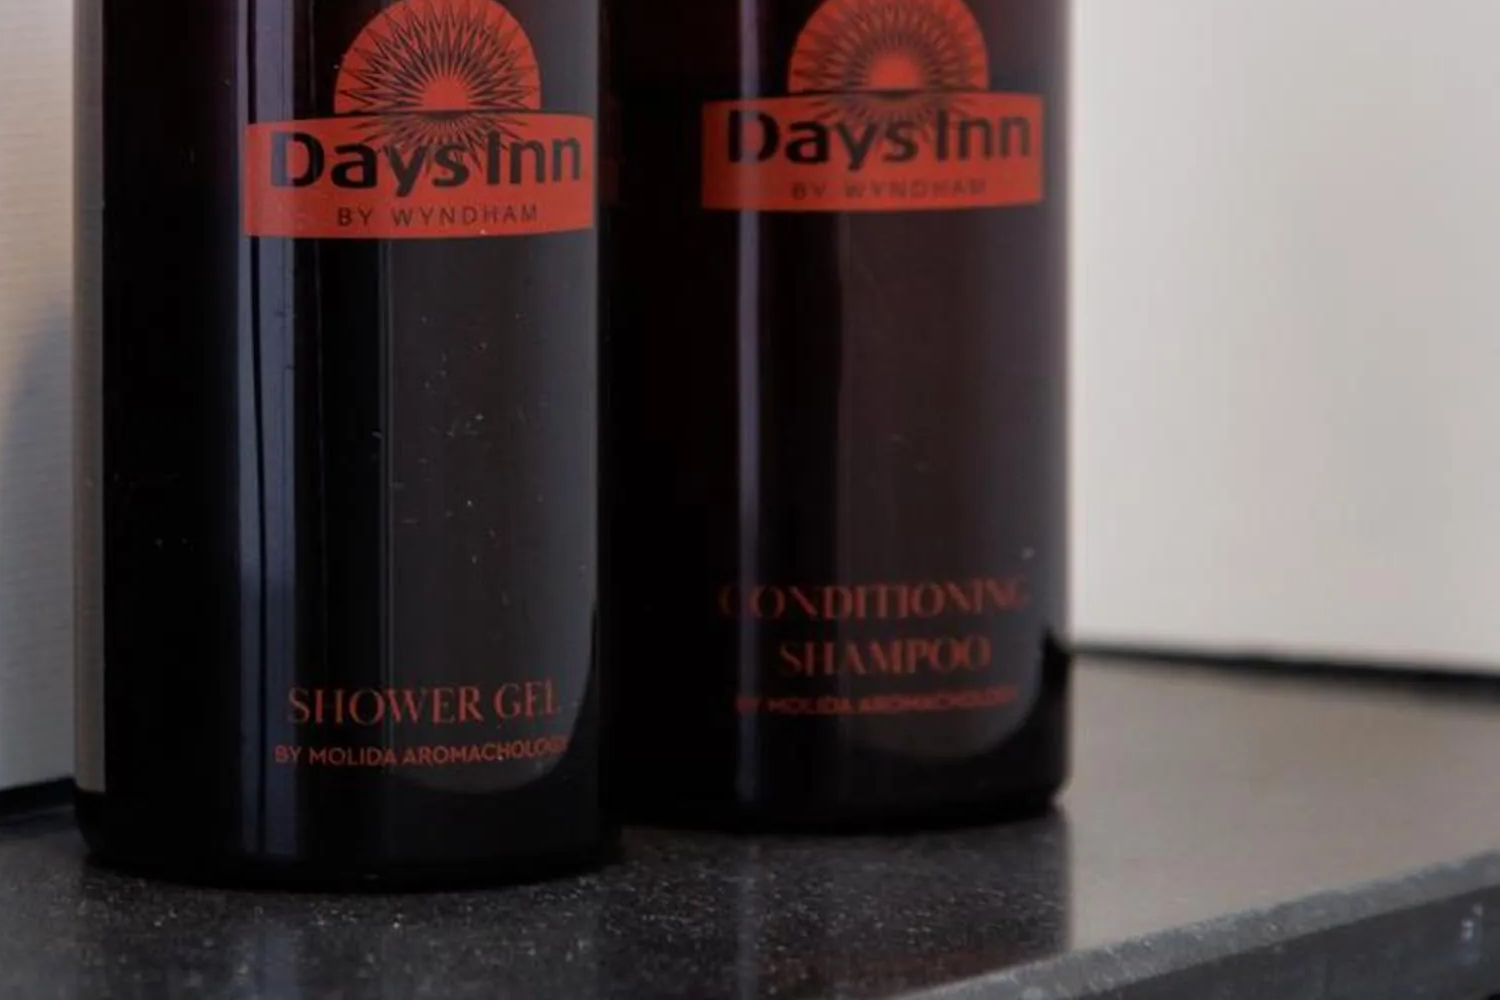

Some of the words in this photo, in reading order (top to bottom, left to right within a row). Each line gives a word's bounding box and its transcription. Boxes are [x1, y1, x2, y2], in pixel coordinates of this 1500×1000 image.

[726, 109, 920, 172] Days
[935, 109, 1032, 162] Inn
[270, 131, 468, 198] Days
[484, 130, 582, 186] Inn
[790, 181, 826, 200] BY
[844, 177, 987, 199] WYNDHAM
[337, 206, 373, 228] BY
[391, 203, 538, 228] WYNDHAM
[716, 575, 1030, 620] CONDITIONING
[779, 635, 992, 675] SHAMPOO
[288, 687, 484, 726] SHOWER
[493, 679, 562, 720] GEL
[274, 745, 302, 764] BY
[309, 746, 398, 767] MOLIDA
